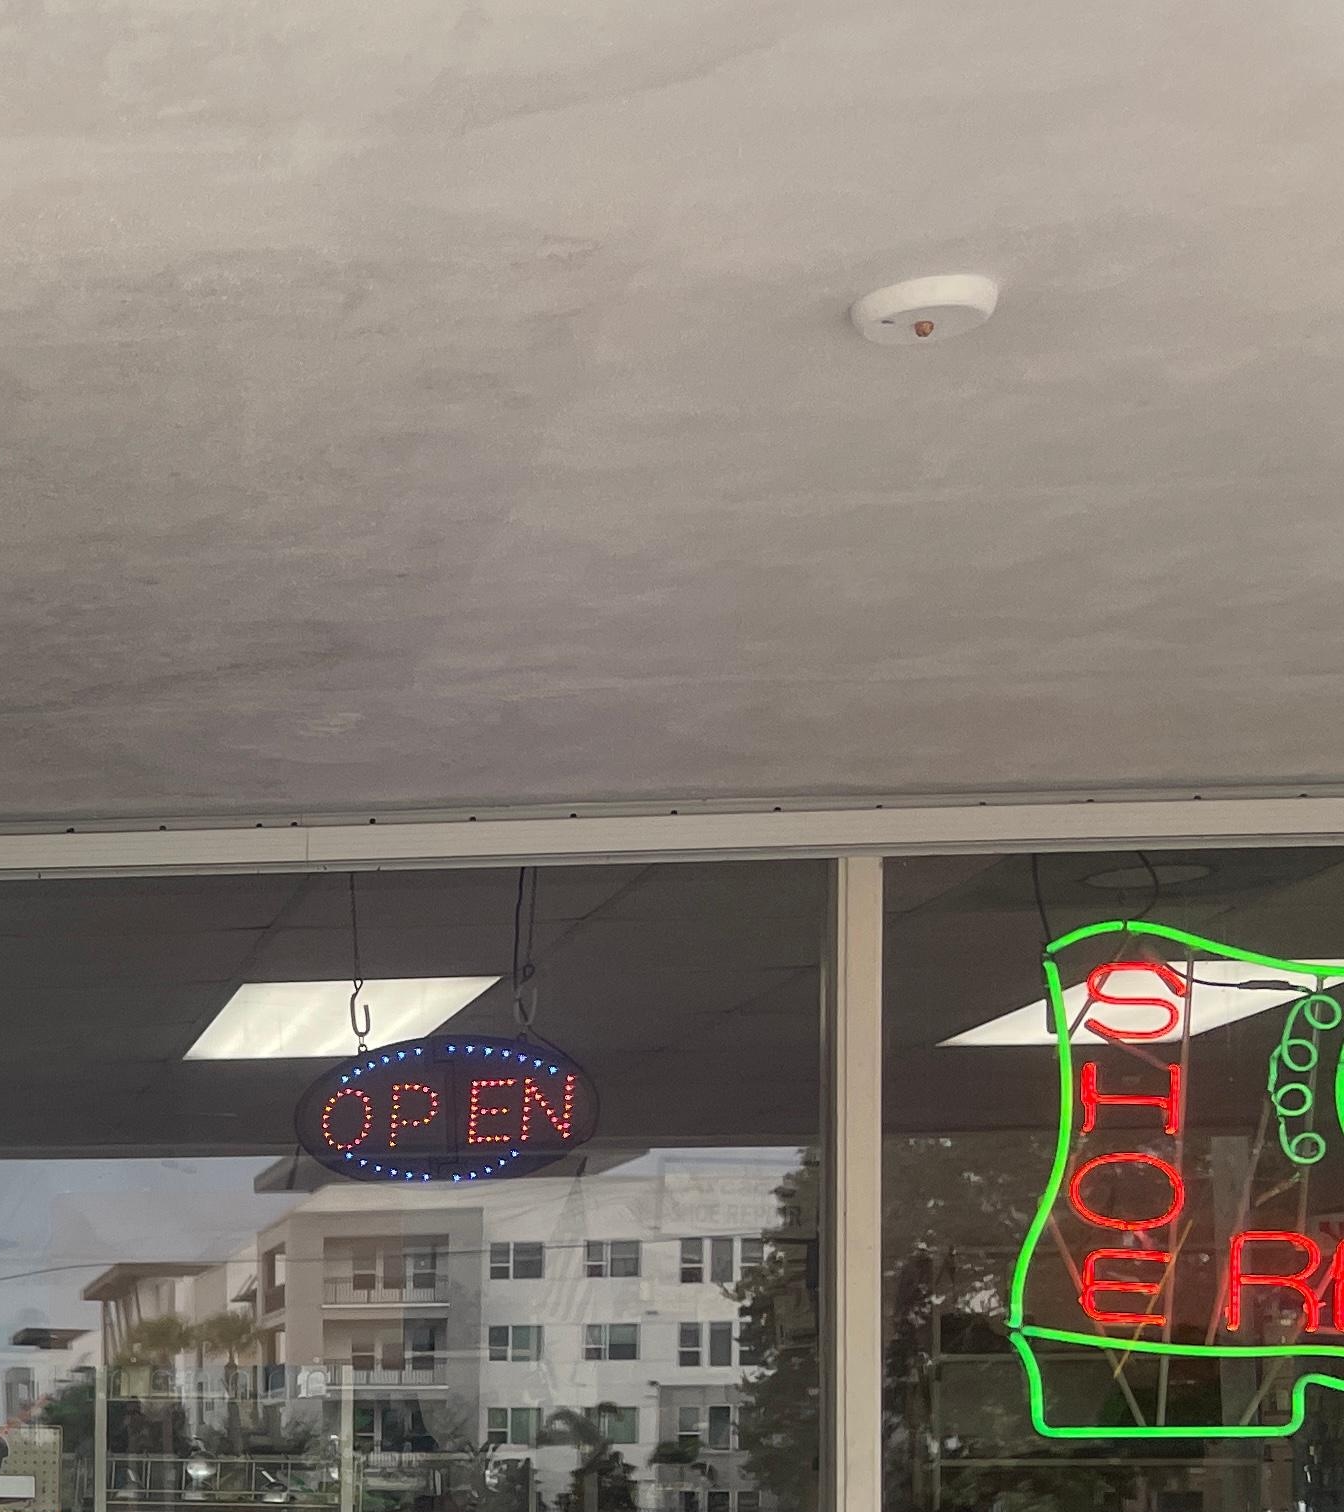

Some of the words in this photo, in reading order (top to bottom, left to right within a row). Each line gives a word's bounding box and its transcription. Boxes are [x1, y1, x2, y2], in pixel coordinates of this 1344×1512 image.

[322, 1073, 577, 1153] OPEN
[1069, 960, 1188, 1327] SHOE
[1226, 1230, 1344, 1333] R
